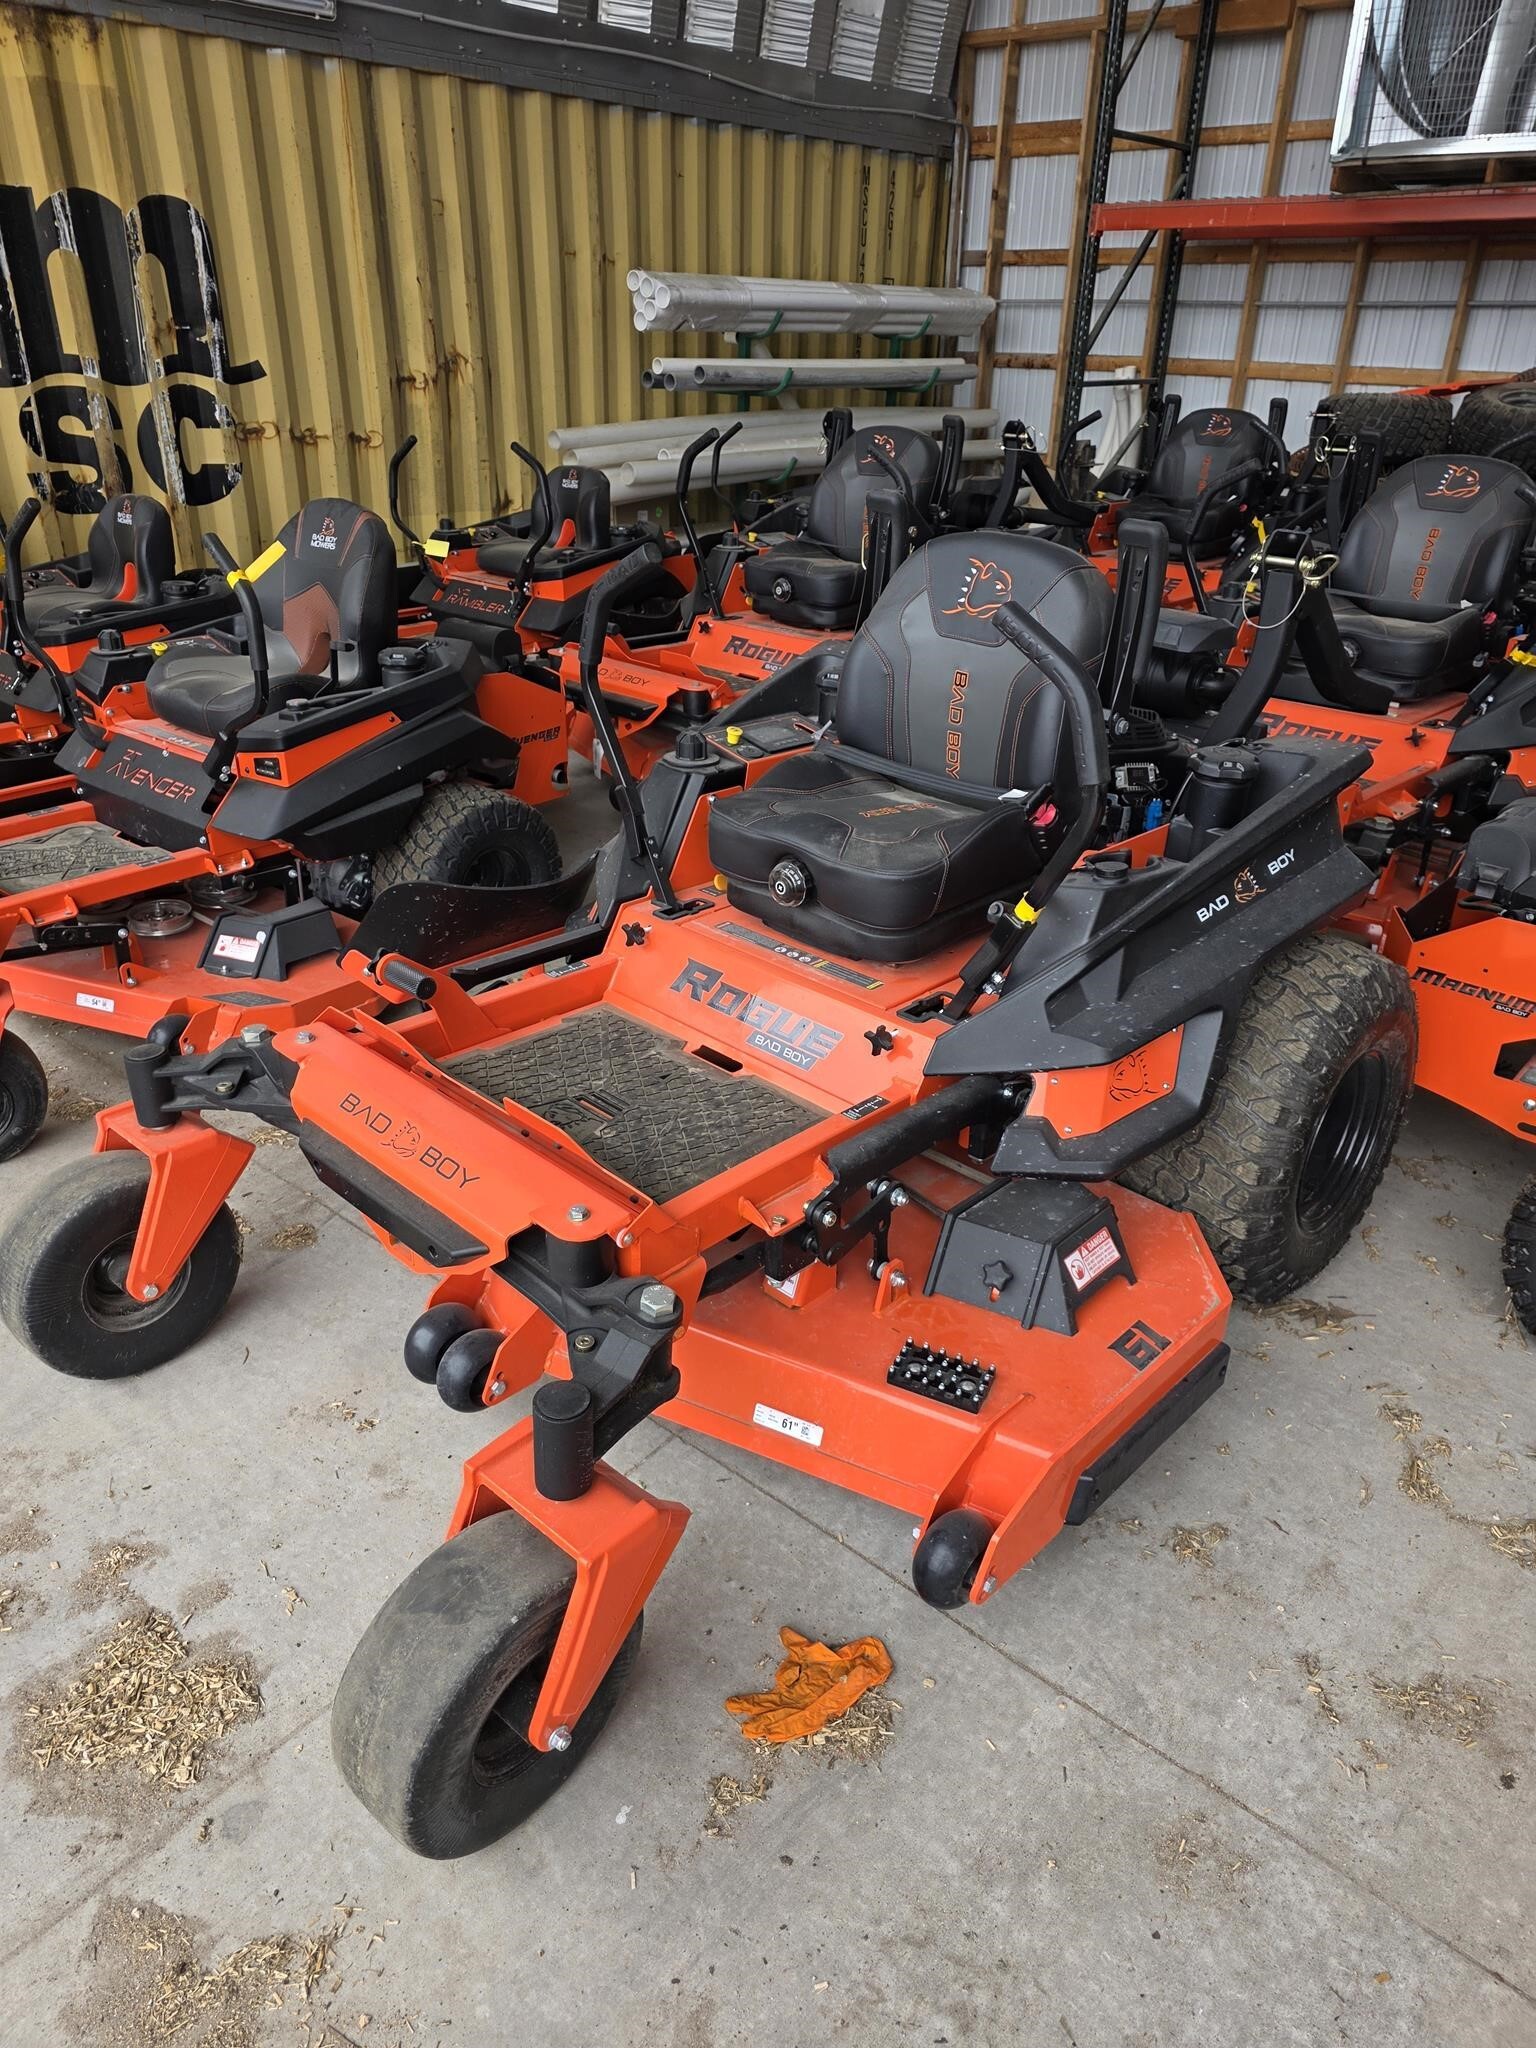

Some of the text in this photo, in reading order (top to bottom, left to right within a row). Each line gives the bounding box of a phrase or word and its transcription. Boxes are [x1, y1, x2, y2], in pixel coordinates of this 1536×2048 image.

[860, 165, 871, 248] MSCU
[310, 540, 336, 550] MOWERS
[311, 533, 338, 543] BAD BOY
[1410, 528, 1441, 601] BAD BOY
[446, 593, 505, 615] RAMBLER
[622, 673, 651, 687] BOY
[945, 669, 969, 780] BAD BOY
[105, 761, 199, 804] AVENGER
[1196, 847, 1296, 923] BAD BOY
[670, 957, 844, 1058] ROGUE
[1410, 965, 1536, 1014] MAGNUM
[1495, 1003, 1529, 1018] BAD BOY
[754, 1035, 812, 1066] BAD BOY
[339, 1092, 481, 1189] BAD BOY
[1086, 1230, 1110, 1252] DANGER
[1107, 1319, 1173, 1372] 61
